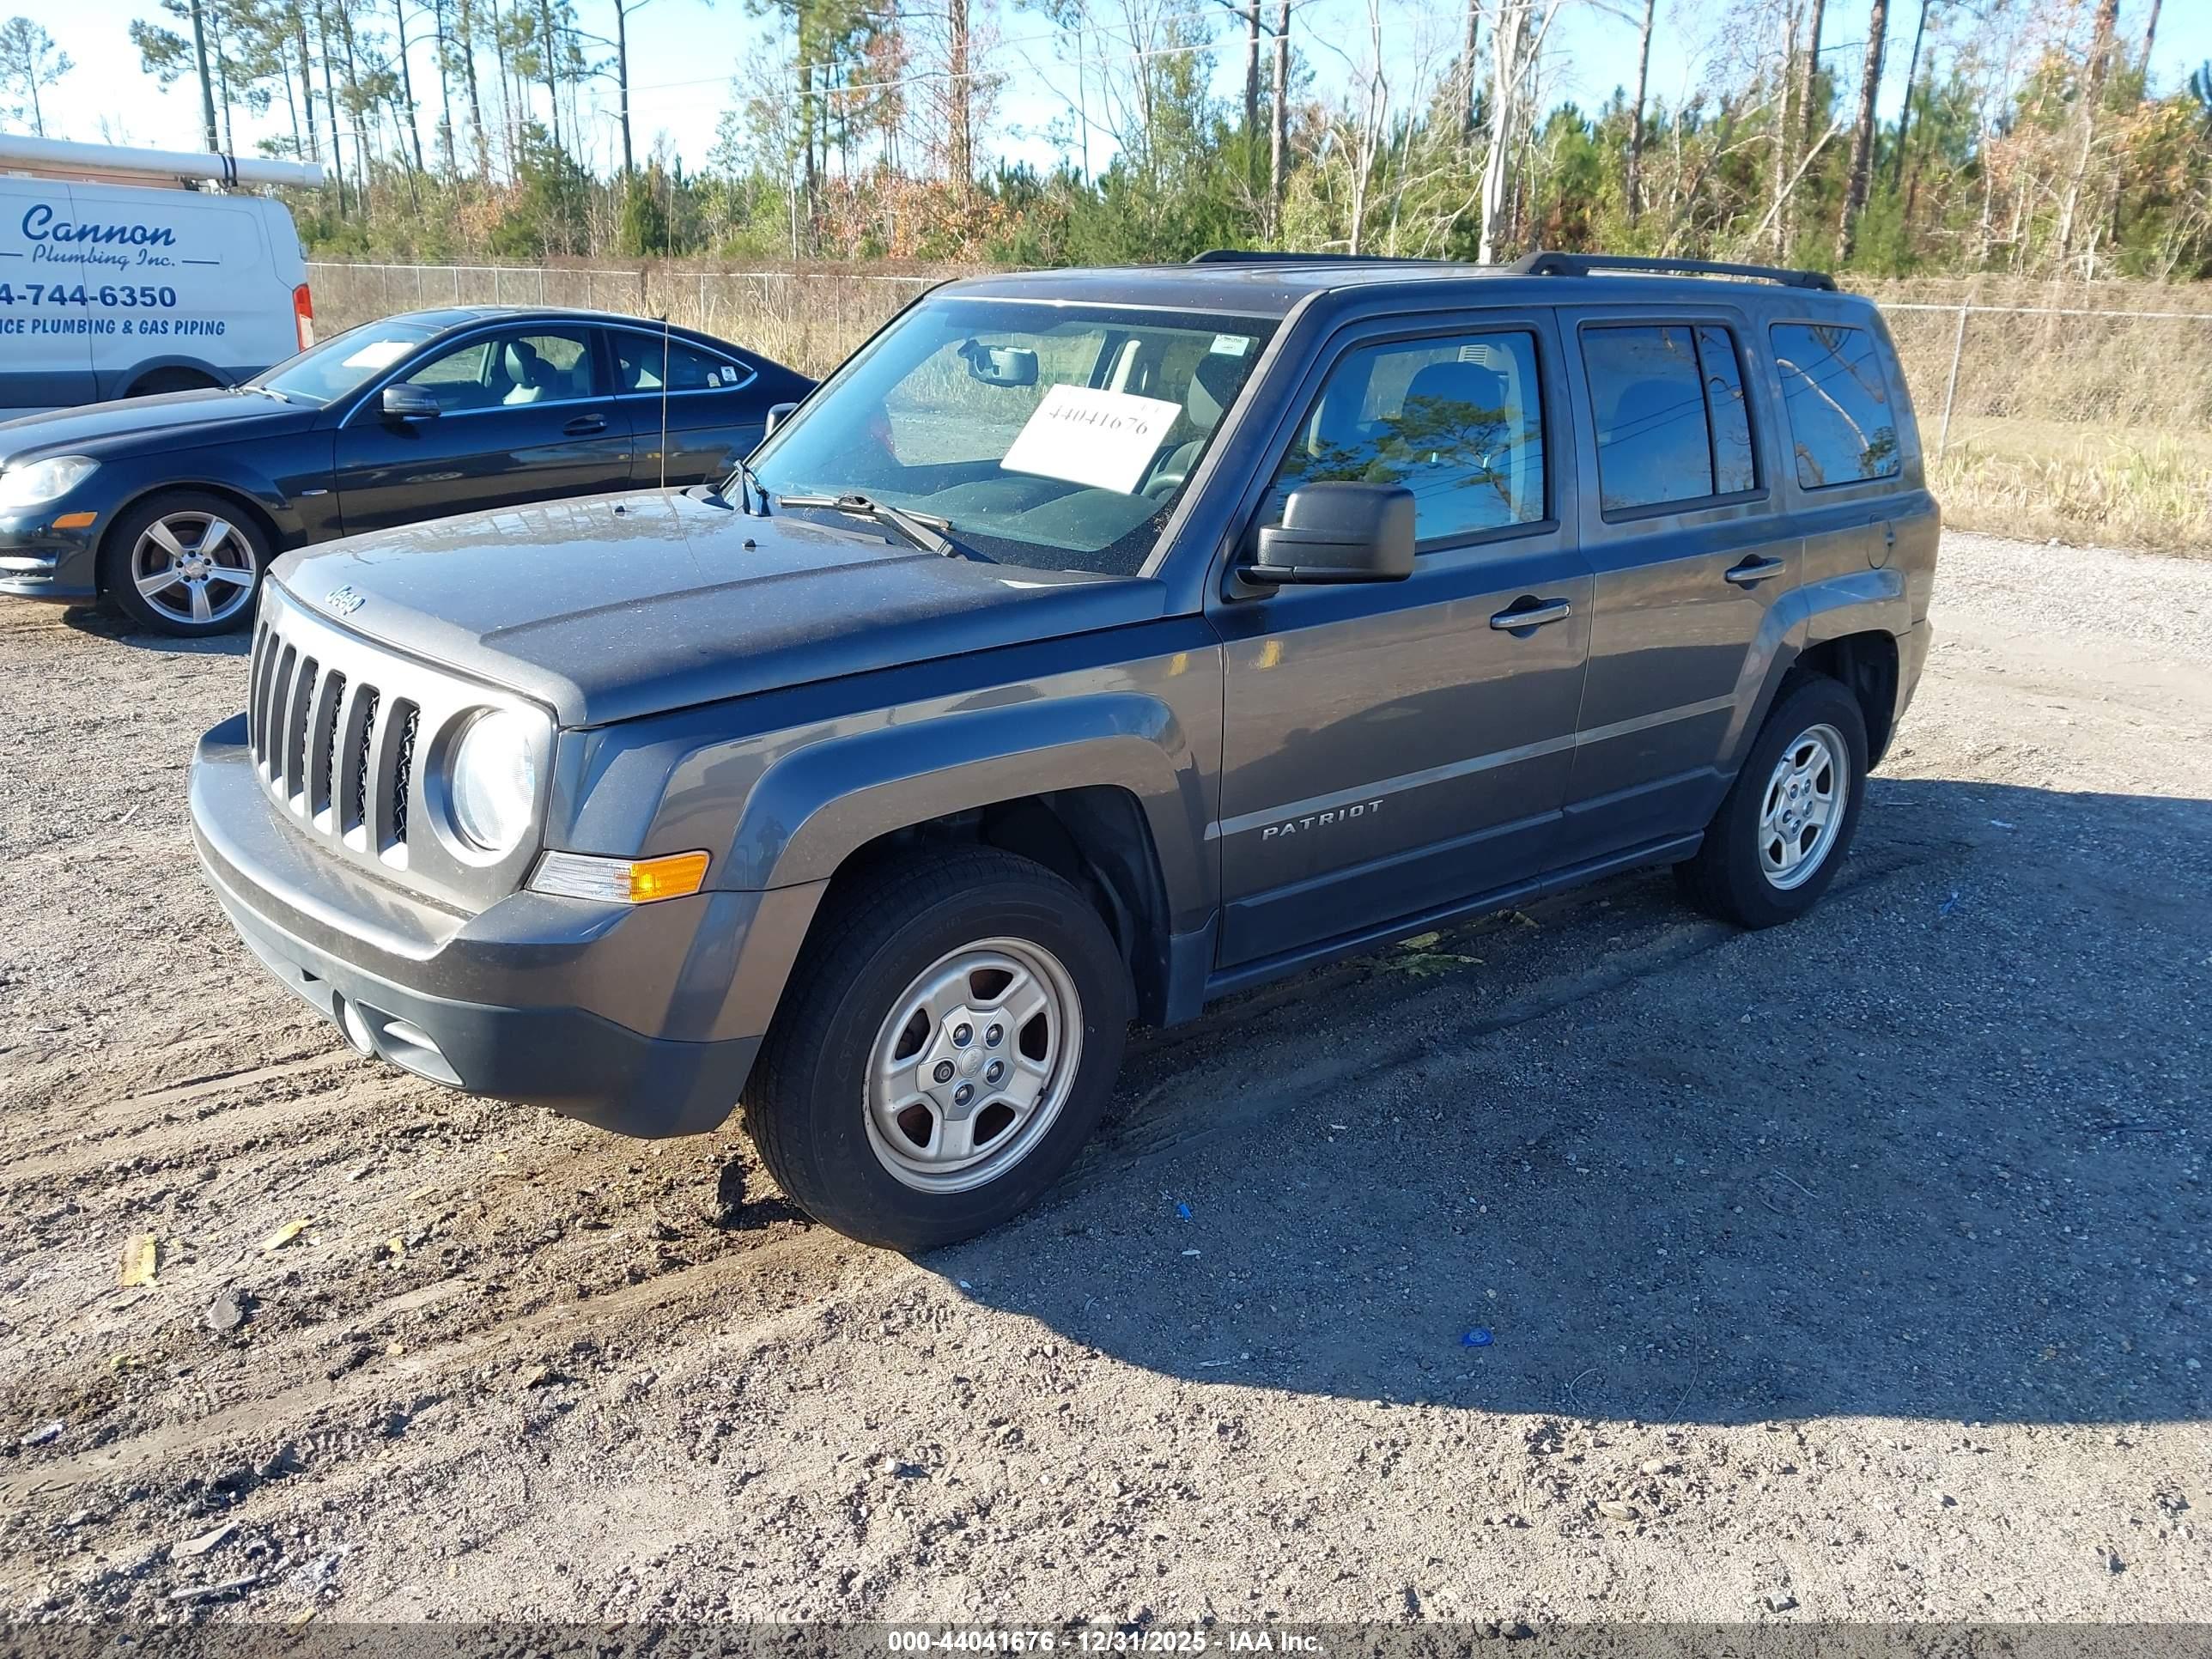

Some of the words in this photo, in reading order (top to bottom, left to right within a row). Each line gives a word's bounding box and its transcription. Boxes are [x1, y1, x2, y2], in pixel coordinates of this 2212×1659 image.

[21, 204, 176, 246] Cannon
[33, 244, 131, 271] Plumbing
[136, 248, 175, 267] Inc.
[0, 283, 177, 307] 4-744-6350
[31, 319, 116, 335] PLUMBING
[121, 319, 133, 335] &
[139, 319, 169, 335] GAS
[174, 320, 225, 336] PIPING
[1048, 404, 1149, 435] 44041676
[325, 584, 366, 616] Jeep
[1261, 799, 1384, 841] PATRIOT
